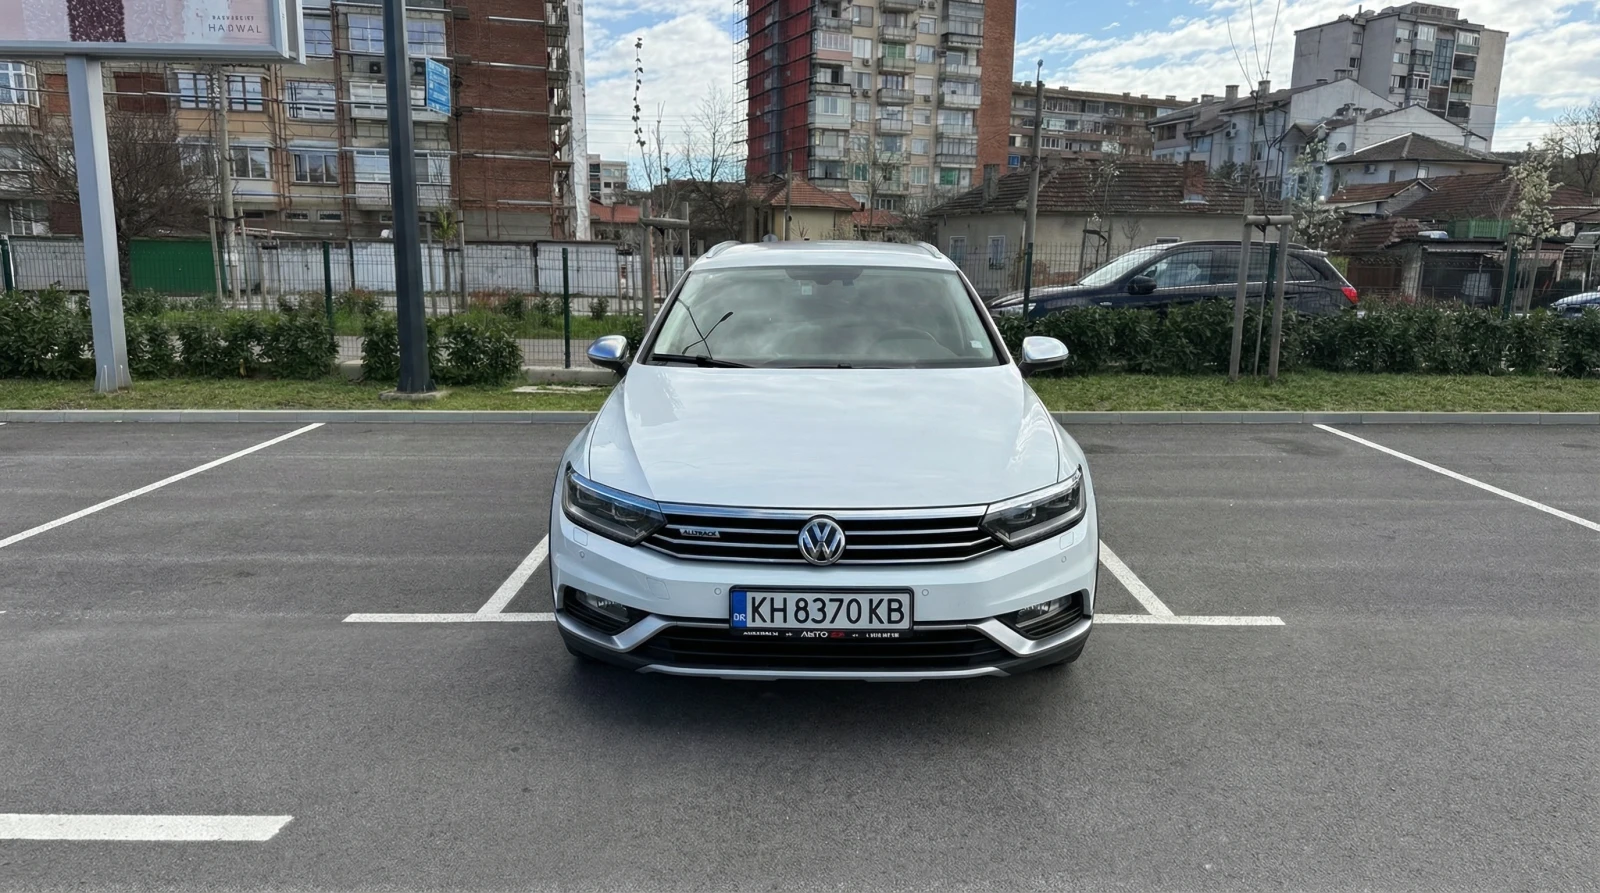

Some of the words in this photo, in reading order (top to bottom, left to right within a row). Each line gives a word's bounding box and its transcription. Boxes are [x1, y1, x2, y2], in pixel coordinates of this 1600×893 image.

[682, 529, 717, 537] ALLTRACK
[800, 518, 845, 565] VW
[751, 596, 788, 624] KH
[793, 597, 862, 625] 8370
[868, 598, 905, 625] KB
